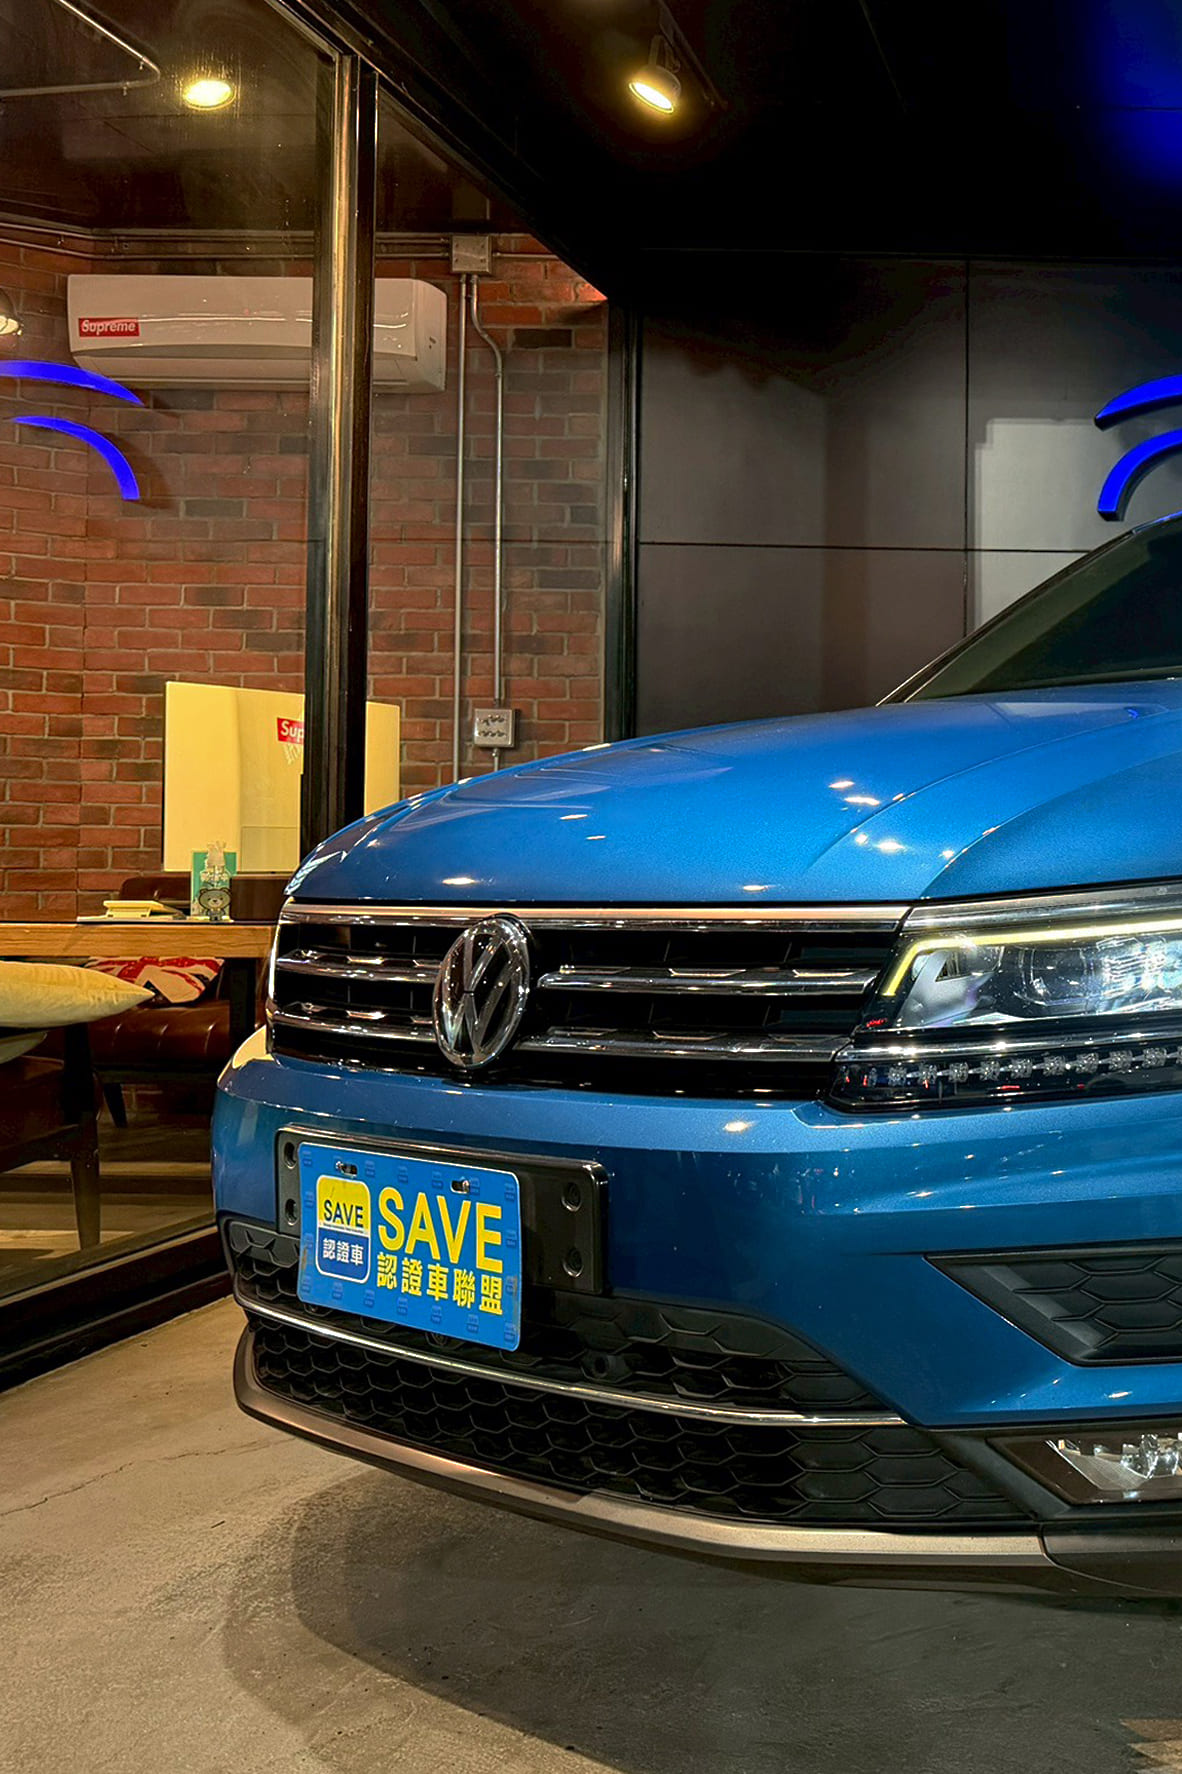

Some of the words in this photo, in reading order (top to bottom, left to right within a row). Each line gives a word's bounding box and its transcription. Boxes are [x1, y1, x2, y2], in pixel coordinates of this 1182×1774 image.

[81, 319, 136, 336] Supreme
[280, 720, 304, 743] Sup
[323, 1199, 364, 1228] SAVE
[378, 1186, 503, 1273] SAVE
[322, 1237, 364, 1266] 認證車
[376, 1251, 503, 1316] 認證車聯盟
